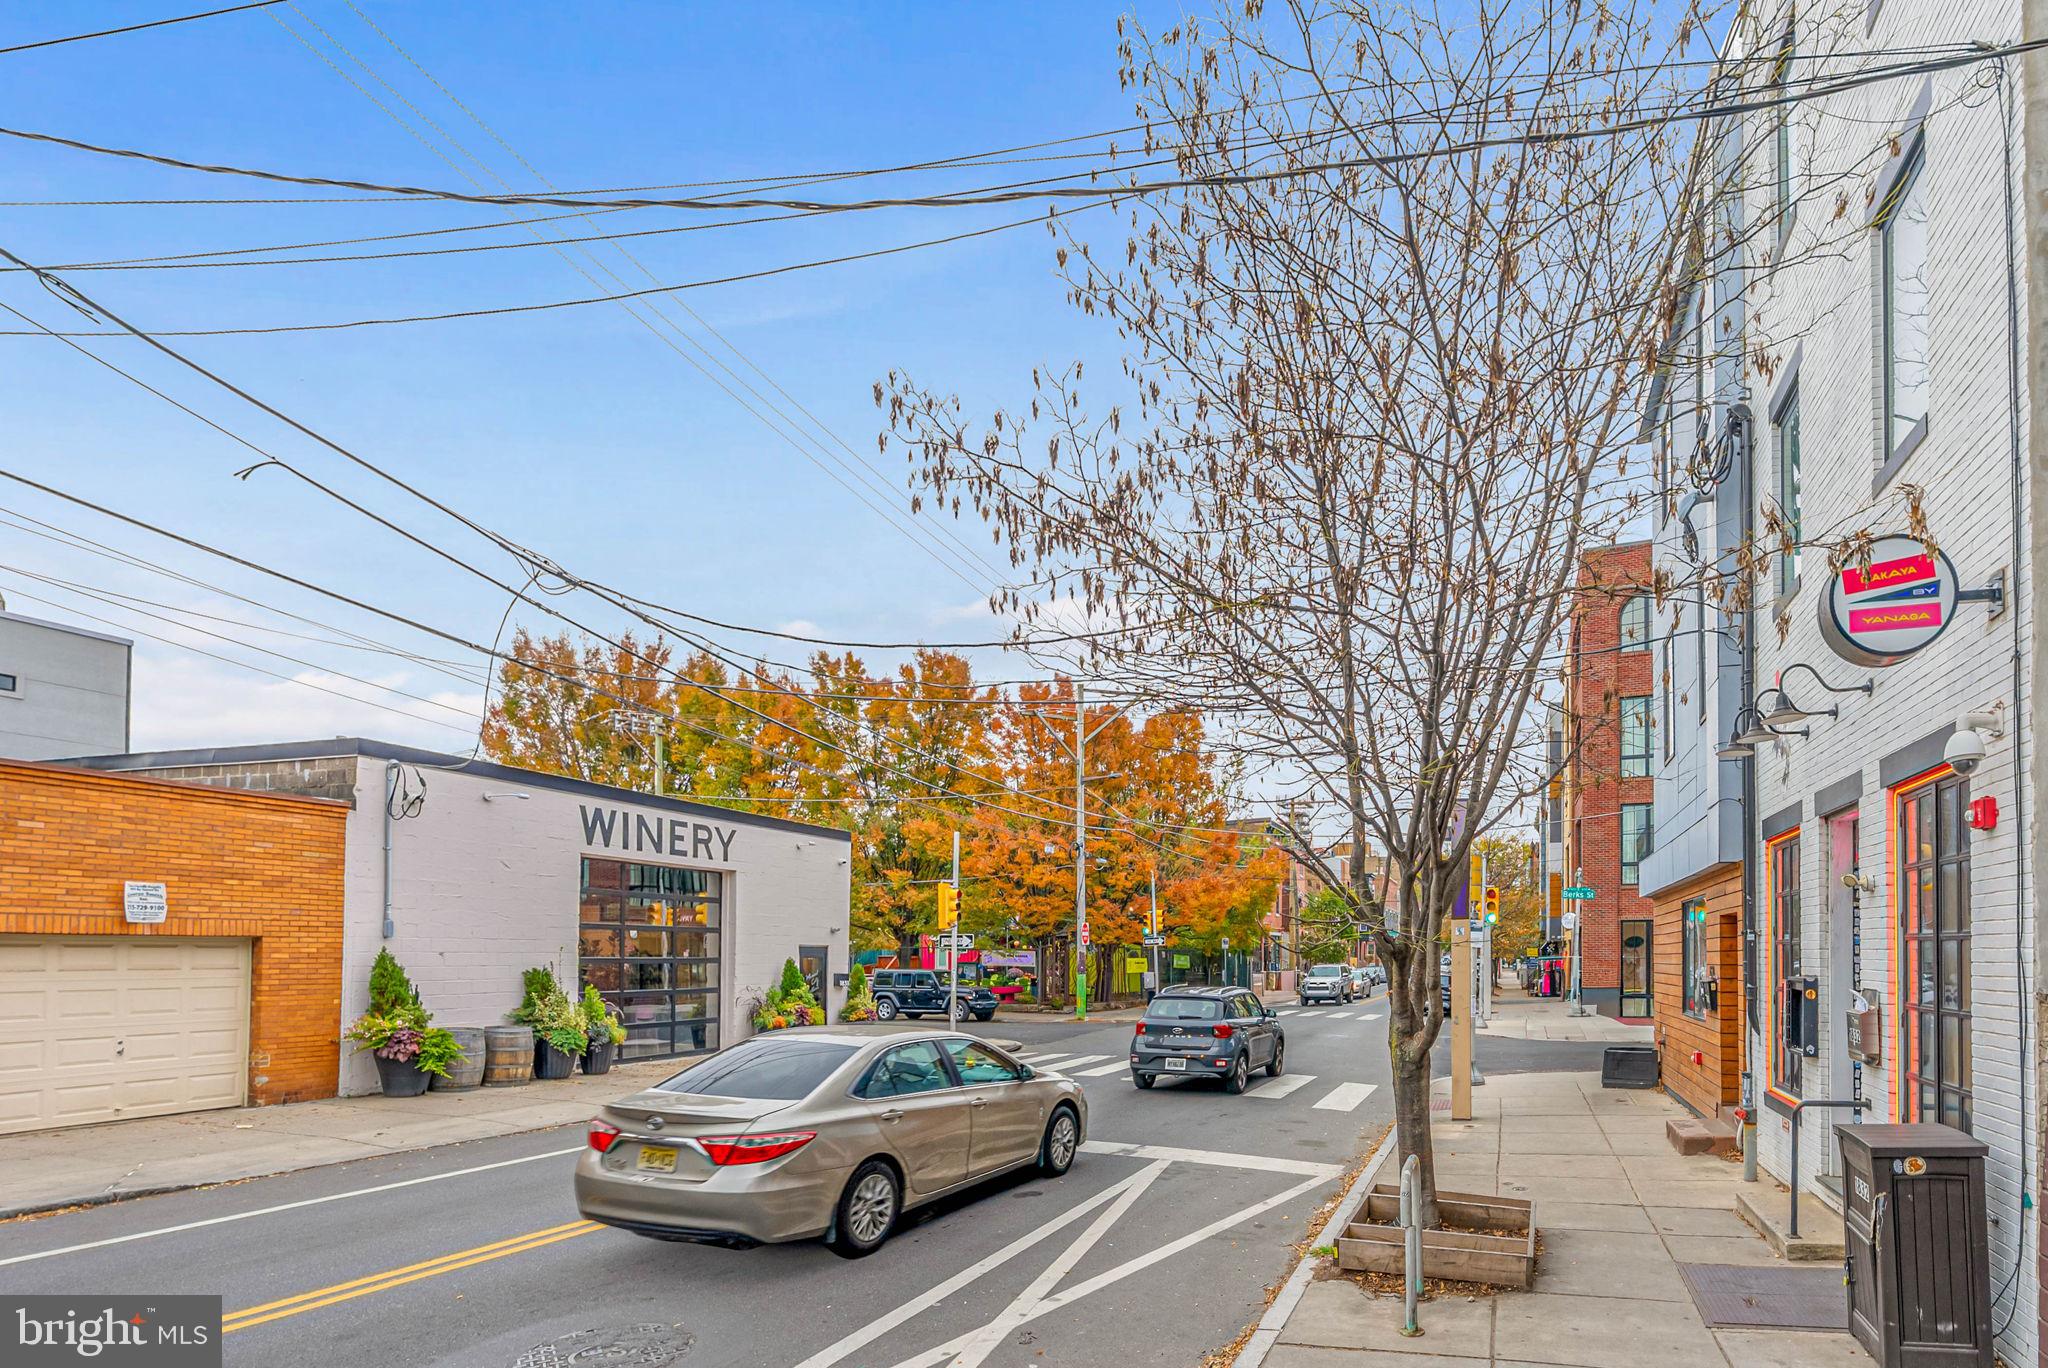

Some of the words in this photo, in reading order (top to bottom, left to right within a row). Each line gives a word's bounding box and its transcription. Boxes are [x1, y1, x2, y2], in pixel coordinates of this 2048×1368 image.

[1913, 587, 1935, 596] BY
[579, 804, 737, 862] WINERY
[1562, 890, 1584, 898] Berks
[1586, 891, 1594, 899] St
